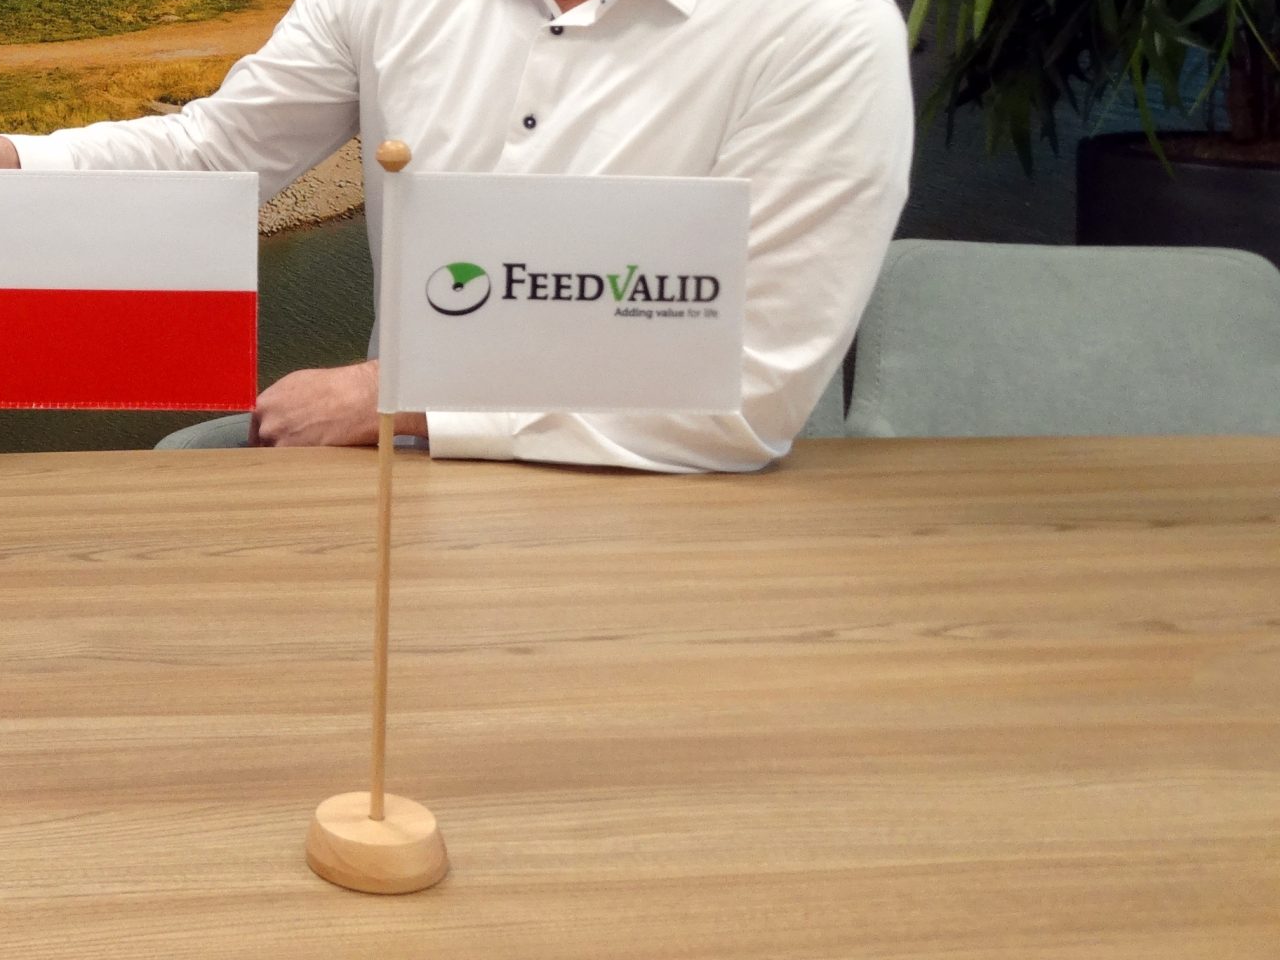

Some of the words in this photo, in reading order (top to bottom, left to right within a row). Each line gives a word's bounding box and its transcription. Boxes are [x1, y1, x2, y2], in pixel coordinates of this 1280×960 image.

[614, 307, 654, 319] Adding
[656, 309, 685, 318] value
[687, 308, 701, 318] for
